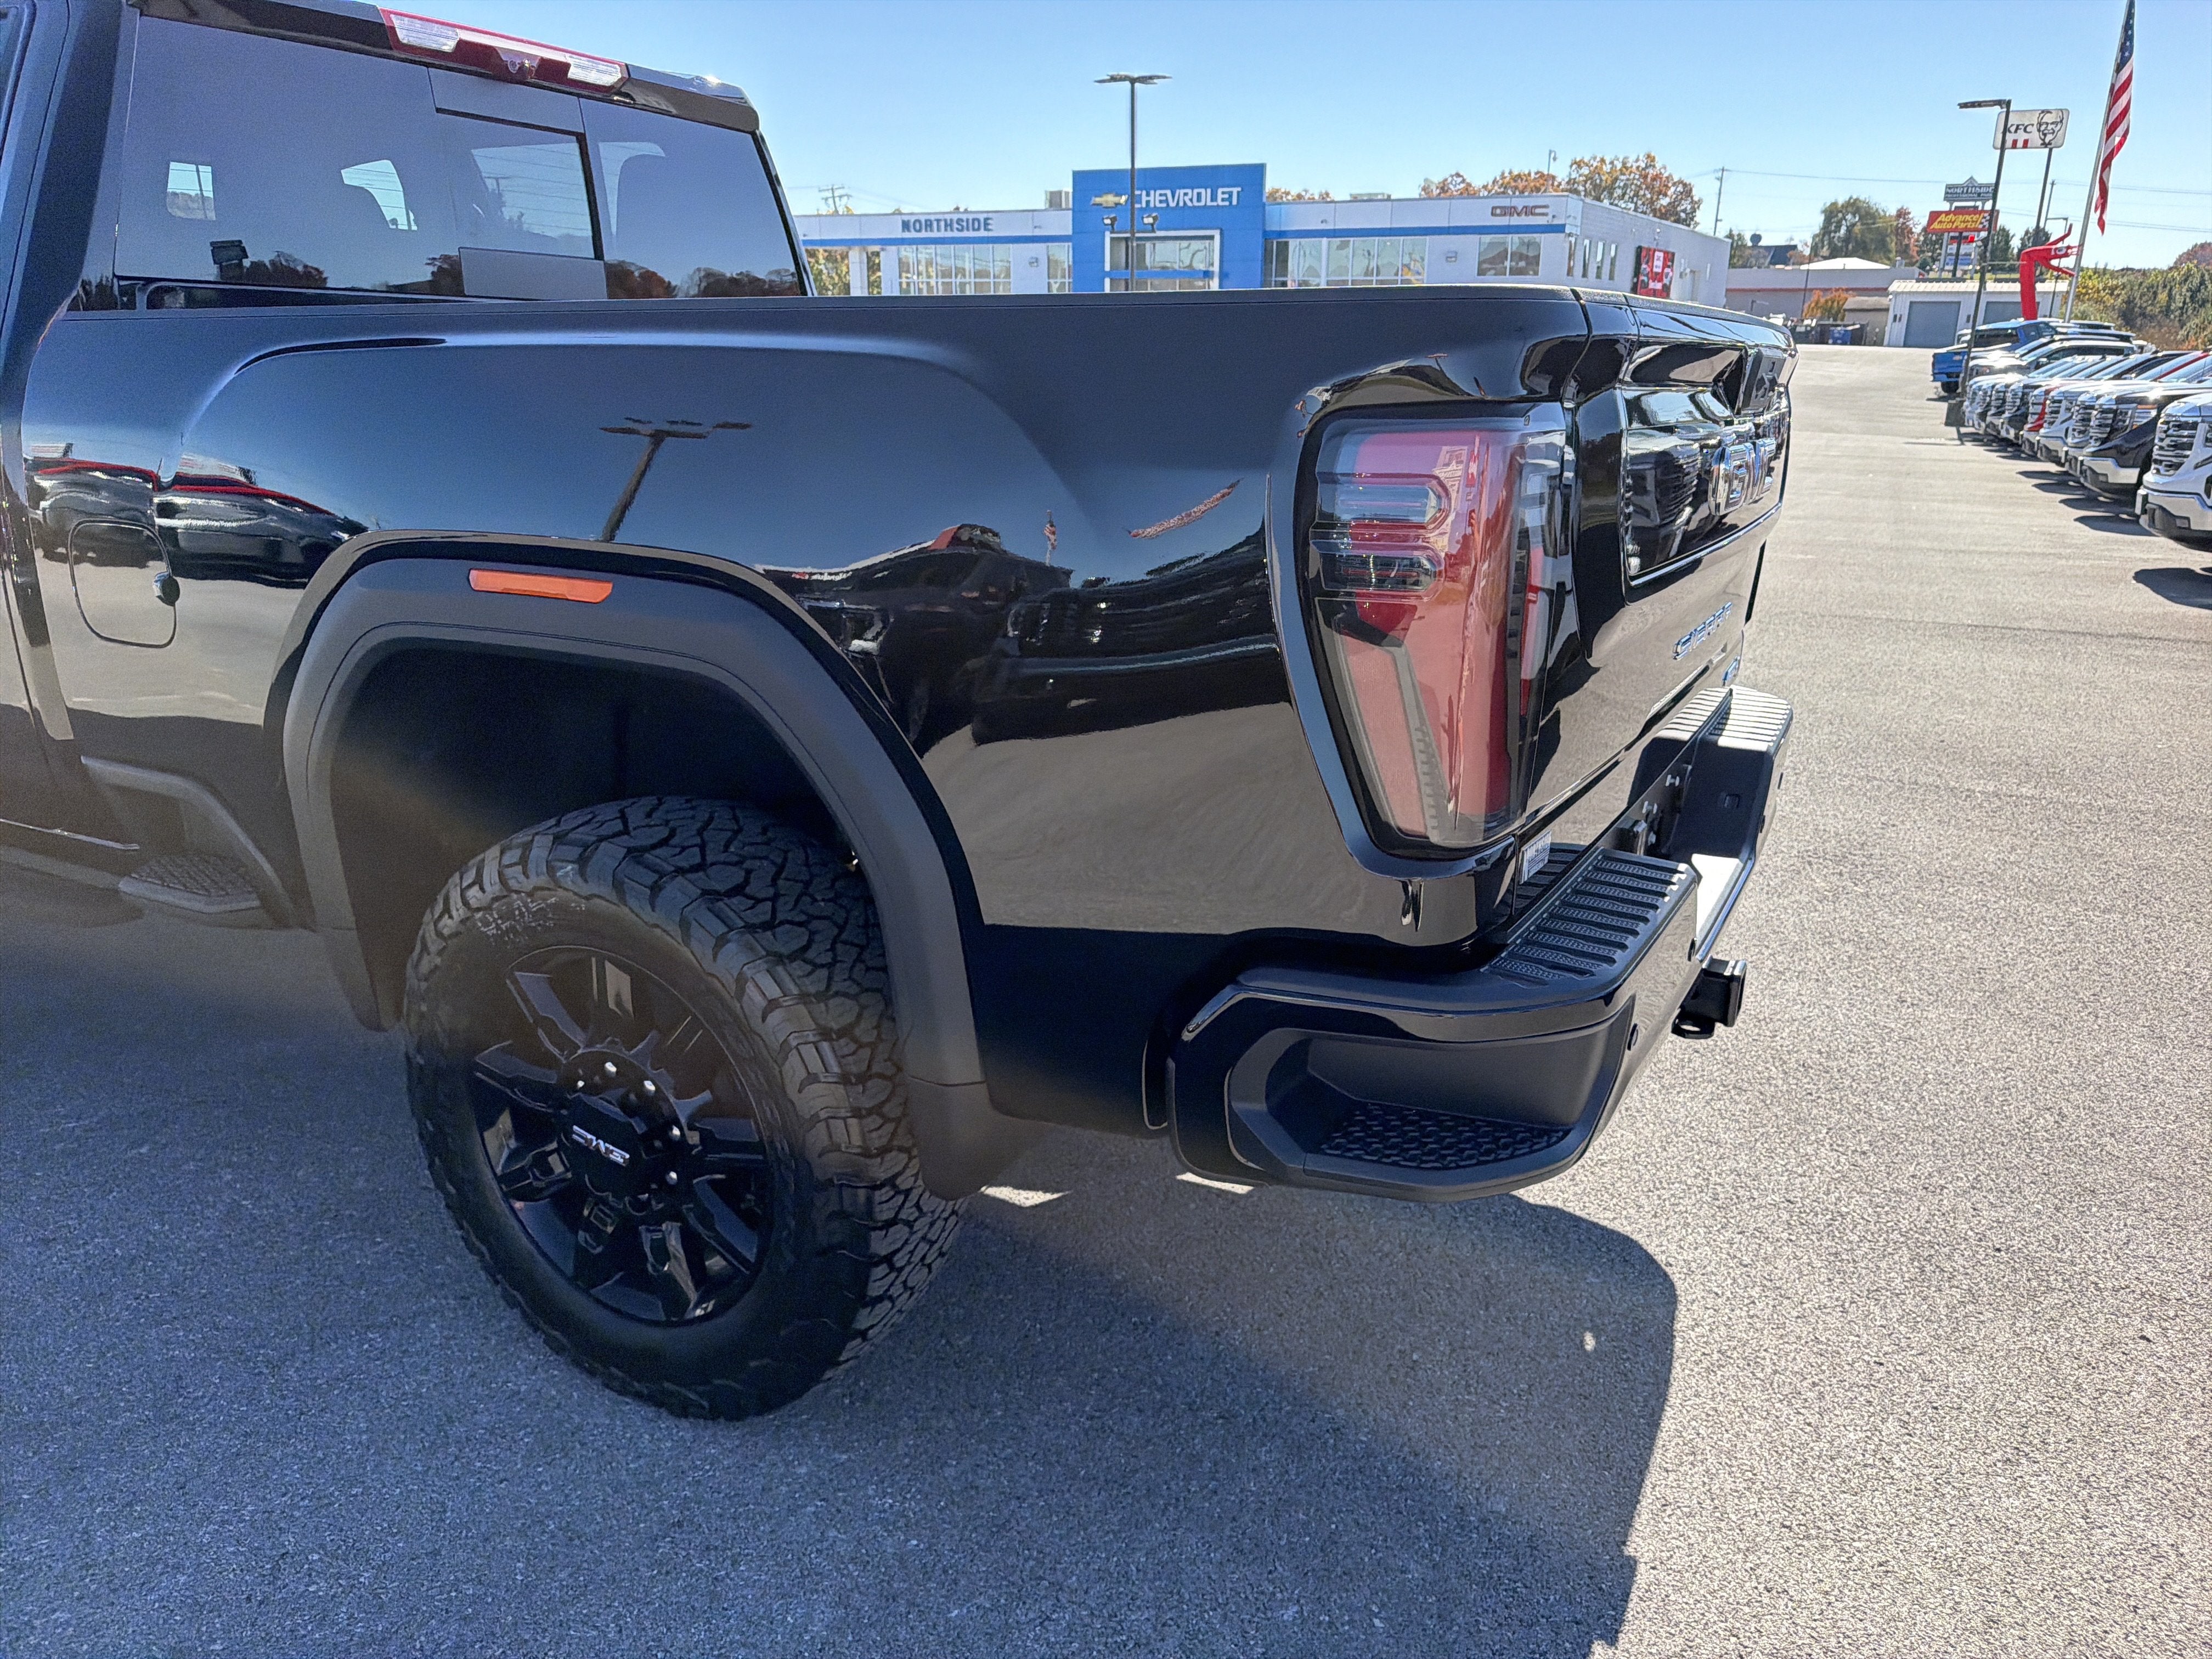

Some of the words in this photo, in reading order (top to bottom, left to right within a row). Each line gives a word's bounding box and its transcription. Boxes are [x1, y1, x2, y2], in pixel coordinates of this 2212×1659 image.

[2002, 123, 2035, 134] KFC
[1134, 187, 1242, 208] CHEVROLET
[1491, 204, 1549, 217] GMC
[1939, 213, 1979, 222] Advance
[901, 217, 994, 233] NORTHSIDE
[1930, 221, 1953, 229] Auto
[1953, 221, 1977, 229] Parts
[1672, 601, 1733, 662] SIERRA
[572, 1125, 630, 1167] GMC
